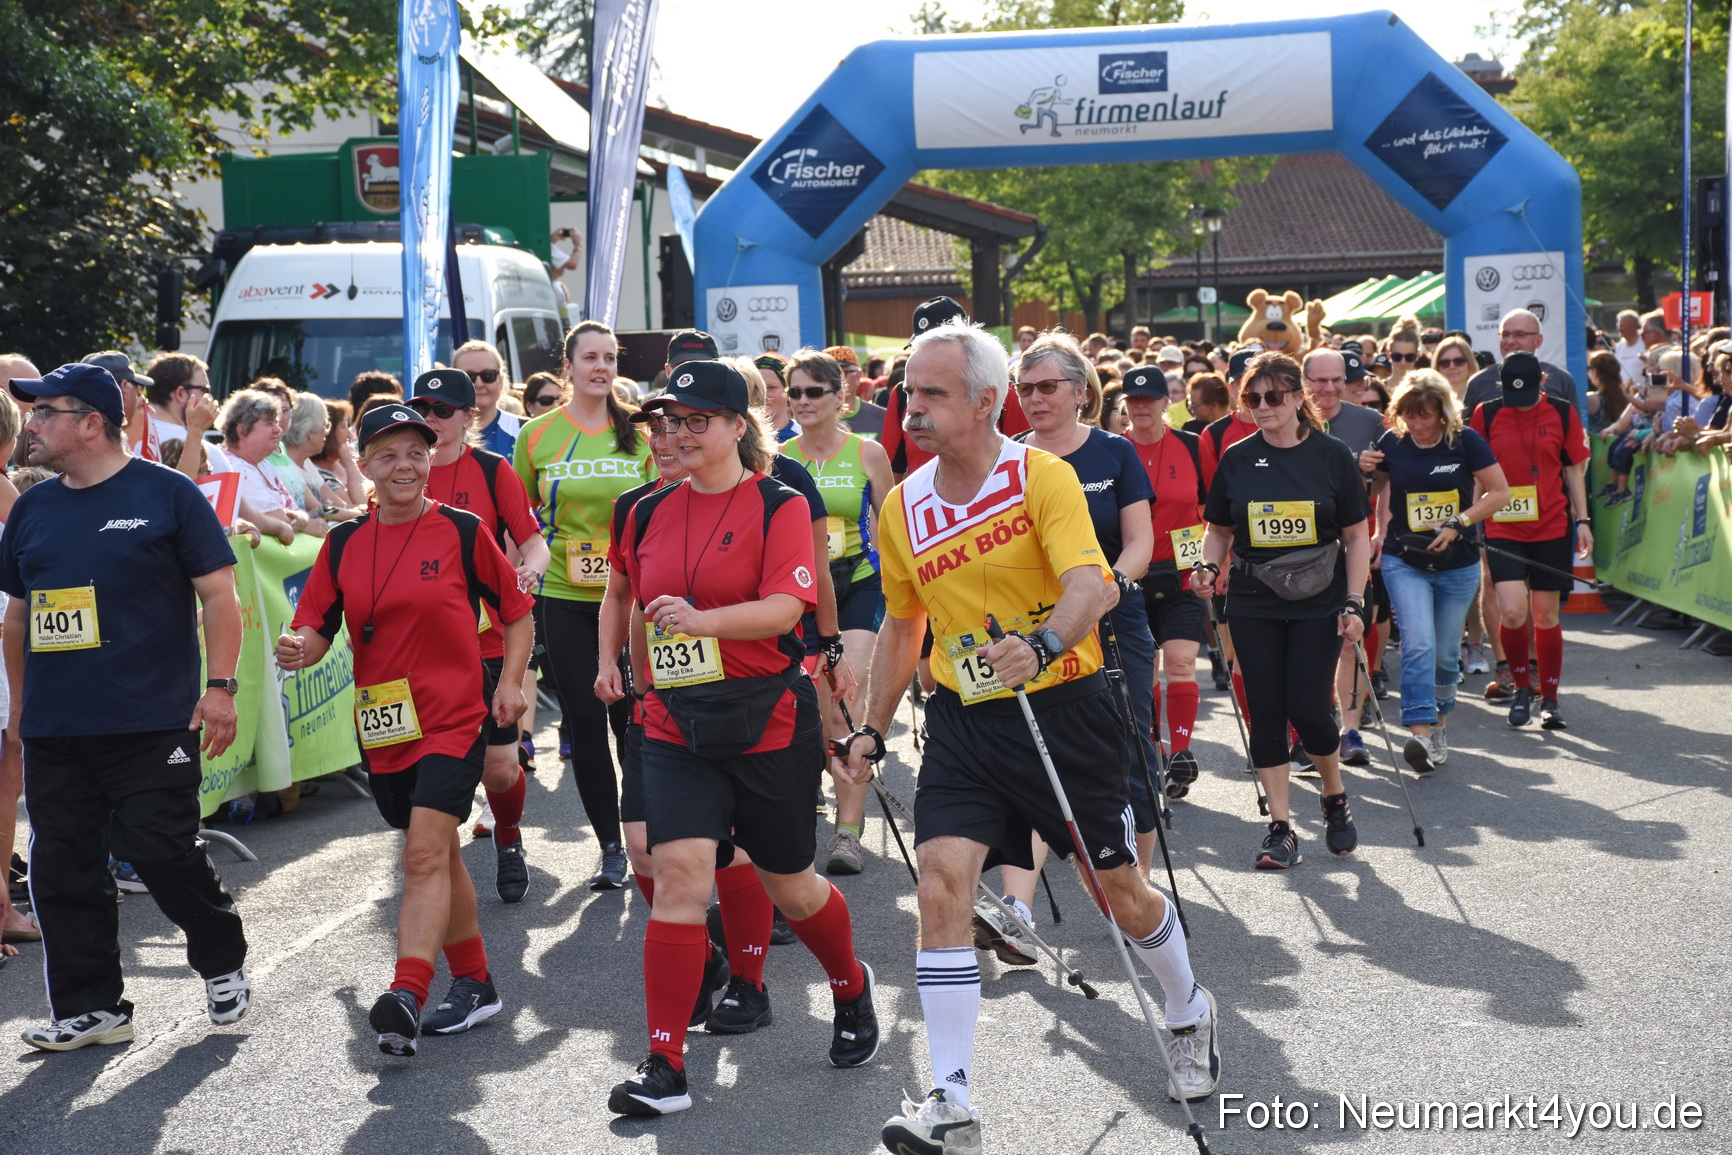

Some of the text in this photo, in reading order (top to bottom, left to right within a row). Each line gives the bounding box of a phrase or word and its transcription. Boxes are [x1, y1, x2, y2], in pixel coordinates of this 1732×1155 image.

[1113, 67, 1164, 79] Fischer
[1075, 90, 1228, 125] firmenlauf
[1075, 125, 1138, 136] neumarkt
[1393, 133, 1416, 146] und
[1419, 129, 1441, 141] das
[784, 161, 865, 179] Fischer
[791, 179, 858, 188] AUTOMOBILE
[238, 285, 304, 299] abavent
[546, 458, 640, 481] BOCK
[456, 492, 469, 505] 21
[1414, 504, 1454, 521] 1379
[1258, 518, 1307, 535] 1999
[722, 531, 734, 546] 8
[420, 559, 440, 576] 24
[917, 543, 972, 586] MAX
[35, 610, 83, 635] 1401
[653, 640, 706, 670] 2331
[681, 667, 694, 675] Elke
[301, 702, 336, 738] neumarkt
[361, 703, 403, 731] 2357
[167, 757, 191, 765] adidas
